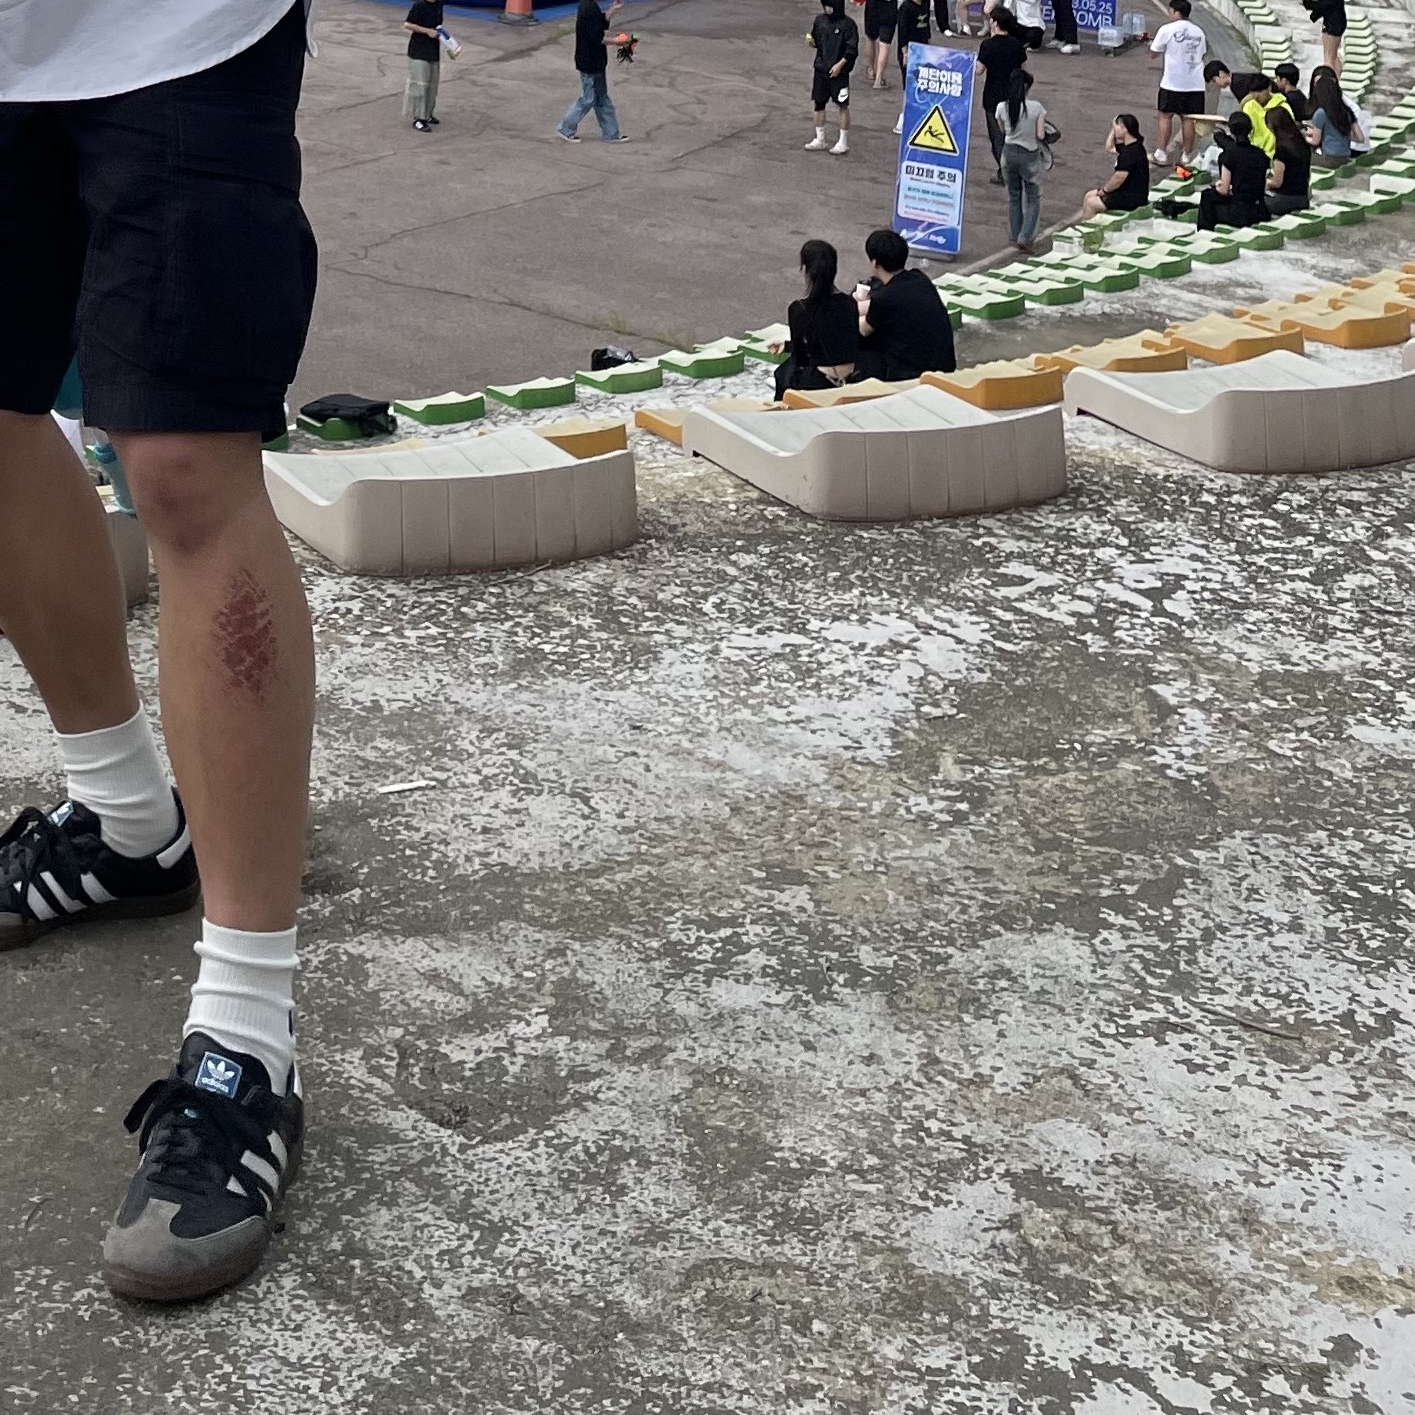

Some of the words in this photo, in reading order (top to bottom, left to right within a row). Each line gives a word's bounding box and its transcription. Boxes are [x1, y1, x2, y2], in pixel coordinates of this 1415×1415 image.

[1072, 9, 1113, 28] OMB
[937, 169, 957, 184] 주의
[201, 1077, 229, 1093] adidas
